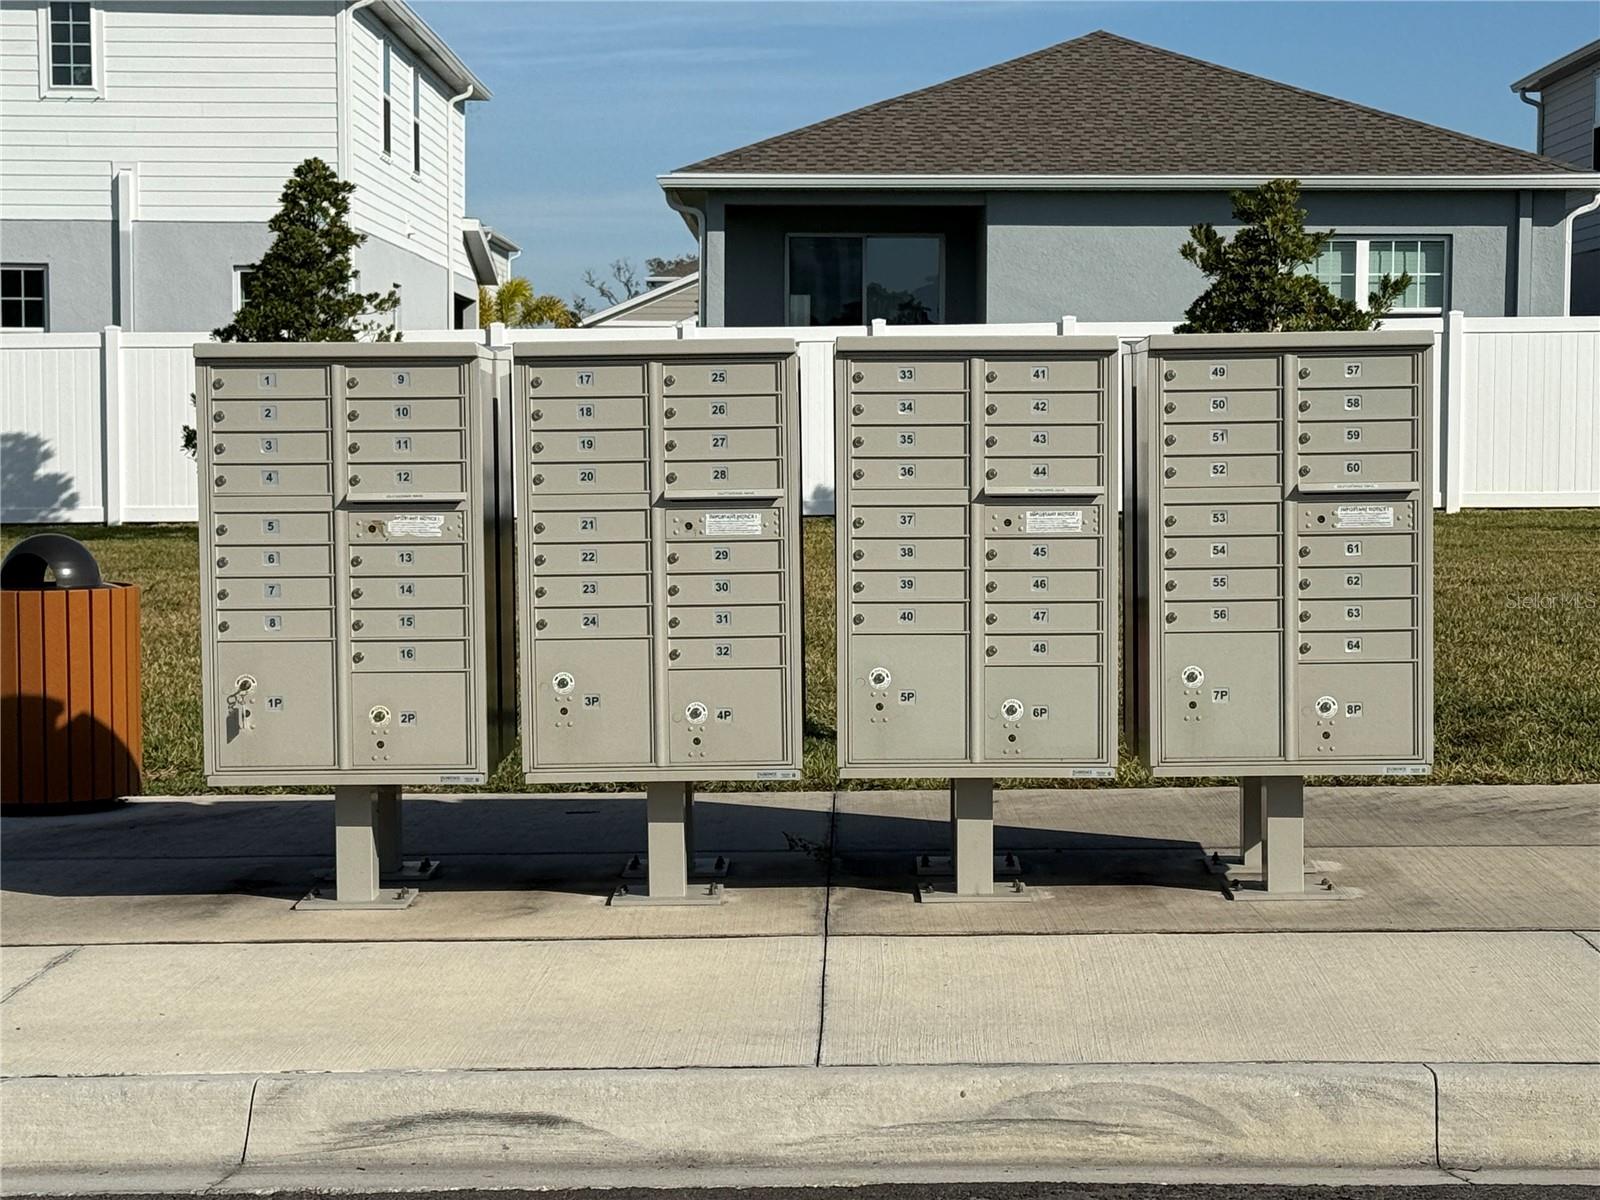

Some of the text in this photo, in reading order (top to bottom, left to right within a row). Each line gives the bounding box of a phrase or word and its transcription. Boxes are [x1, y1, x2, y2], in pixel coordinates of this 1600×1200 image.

[899, 369, 913, 380] 33
[1032, 368, 1046, 379] 41
[1211, 366, 1226, 377] 49
[1346, 364, 1360, 375] 57
[264, 375, 270, 386] 1
[397, 374, 405, 385] 9
[578, 374, 592, 385] 17
[711, 372, 726, 383] 25
[899, 401, 913, 413] 34
[1032, 401, 1047, 412] 42
[1211, 399, 1226, 410] 50
[1346, 397, 1360, 408] 58
[264, 407, 272, 418] 2
[395, 406, 409, 417] 10
[579, 406, 593, 417] 18
[711, 404, 726, 415] 26
[899, 434, 914, 445] 35
[1032, 433, 1047, 444] 43
[1212, 431, 1225, 442] 51
[1346, 429, 1360, 440] 59
[265, 440, 273, 451] 3
[395, 439, 408, 450] 11
[580, 439, 594, 450] 19
[712, 437, 726, 448] 27
[900, 466, 914, 477] 36
[1032, 466, 1047, 477] 44
[1212, 464, 1226, 475] 52
[1346, 462, 1360, 473] 60
[265, 471, 274, 483] 4
[396, 471, 410, 482] 12
[580, 471, 594, 482] 20
[712, 469, 727, 480] 28
[899, 514, 914, 525] 37
[1212, 512, 1226, 523] 53
[267, 521, 275, 532] 5
[581, 519, 594, 530] 21
[900, 547, 914, 558] 38
[1032, 546, 1047, 557] 45
[1212, 545, 1226, 555] 54
[1346, 543, 1359, 554] 61
[267, 553, 275, 564] 6
[399, 552, 413, 563] 13
[581, 551, 595, 562] 22
[714, 549, 729, 560] 29
[900, 579, 914, 590] 39
[1032, 579, 1047, 589] 46
[1212, 577, 1226, 587] 55
[1346, 575, 1360, 586] 62
[267, 585, 276, 596] 7
[399, 584, 413, 594] 14
[582, 583, 596, 594] 23
[715, 581, 729, 592] 30
[899, 611, 914, 621] 40
[1032, 611, 1047, 621] 47
[1213, 609, 1227, 620] 56
[1346, 607, 1361, 618] 63
[268, 617, 276, 628] 8
[399, 616, 413, 627] 15
[582, 616, 597, 627] 24
[715, 613, 729, 624] 31
[1032, 643, 1047, 653] 48
[1346, 640, 1361, 650] 64
[400, 648, 414, 659] 16
[715, 646, 730, 656] 32
[900, 691, 915, 702] 5P
[1213, 690, 1228, 700] 7P
[267, 697, 283, 708] 1P
[584, 696, 600, 707] 3P
[1032, 707, 1048, 718] 6P
[1346, 704, 1362, 715] 8P
[400, 713, 416, 724] 2P
[716, 710, 732, 721] 4P
